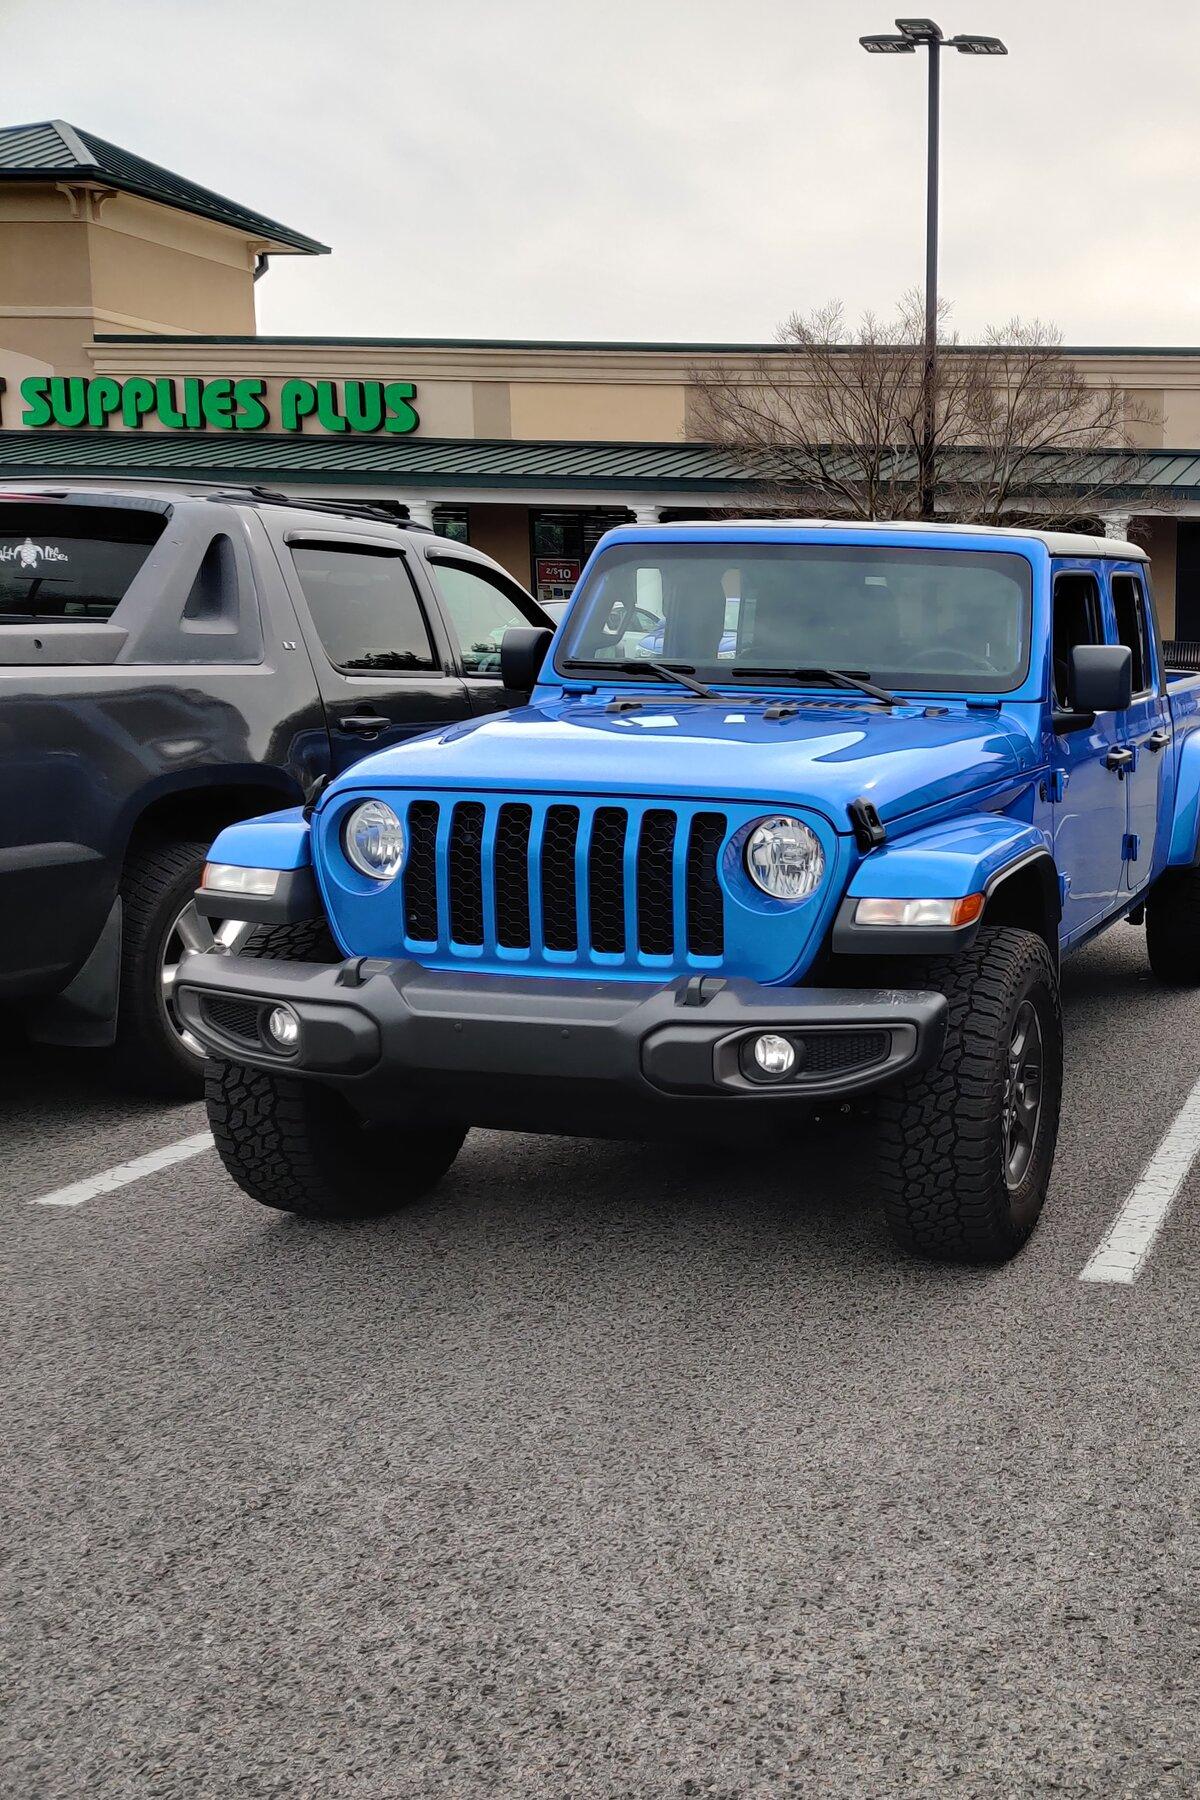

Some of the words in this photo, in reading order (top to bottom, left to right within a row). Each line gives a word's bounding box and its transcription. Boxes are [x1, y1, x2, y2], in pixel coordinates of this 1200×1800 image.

[20, 376, 269, 430] SUPPLIES
[281, 379, 419, 433] PLUS
[283, 641, 296, 650] LT
